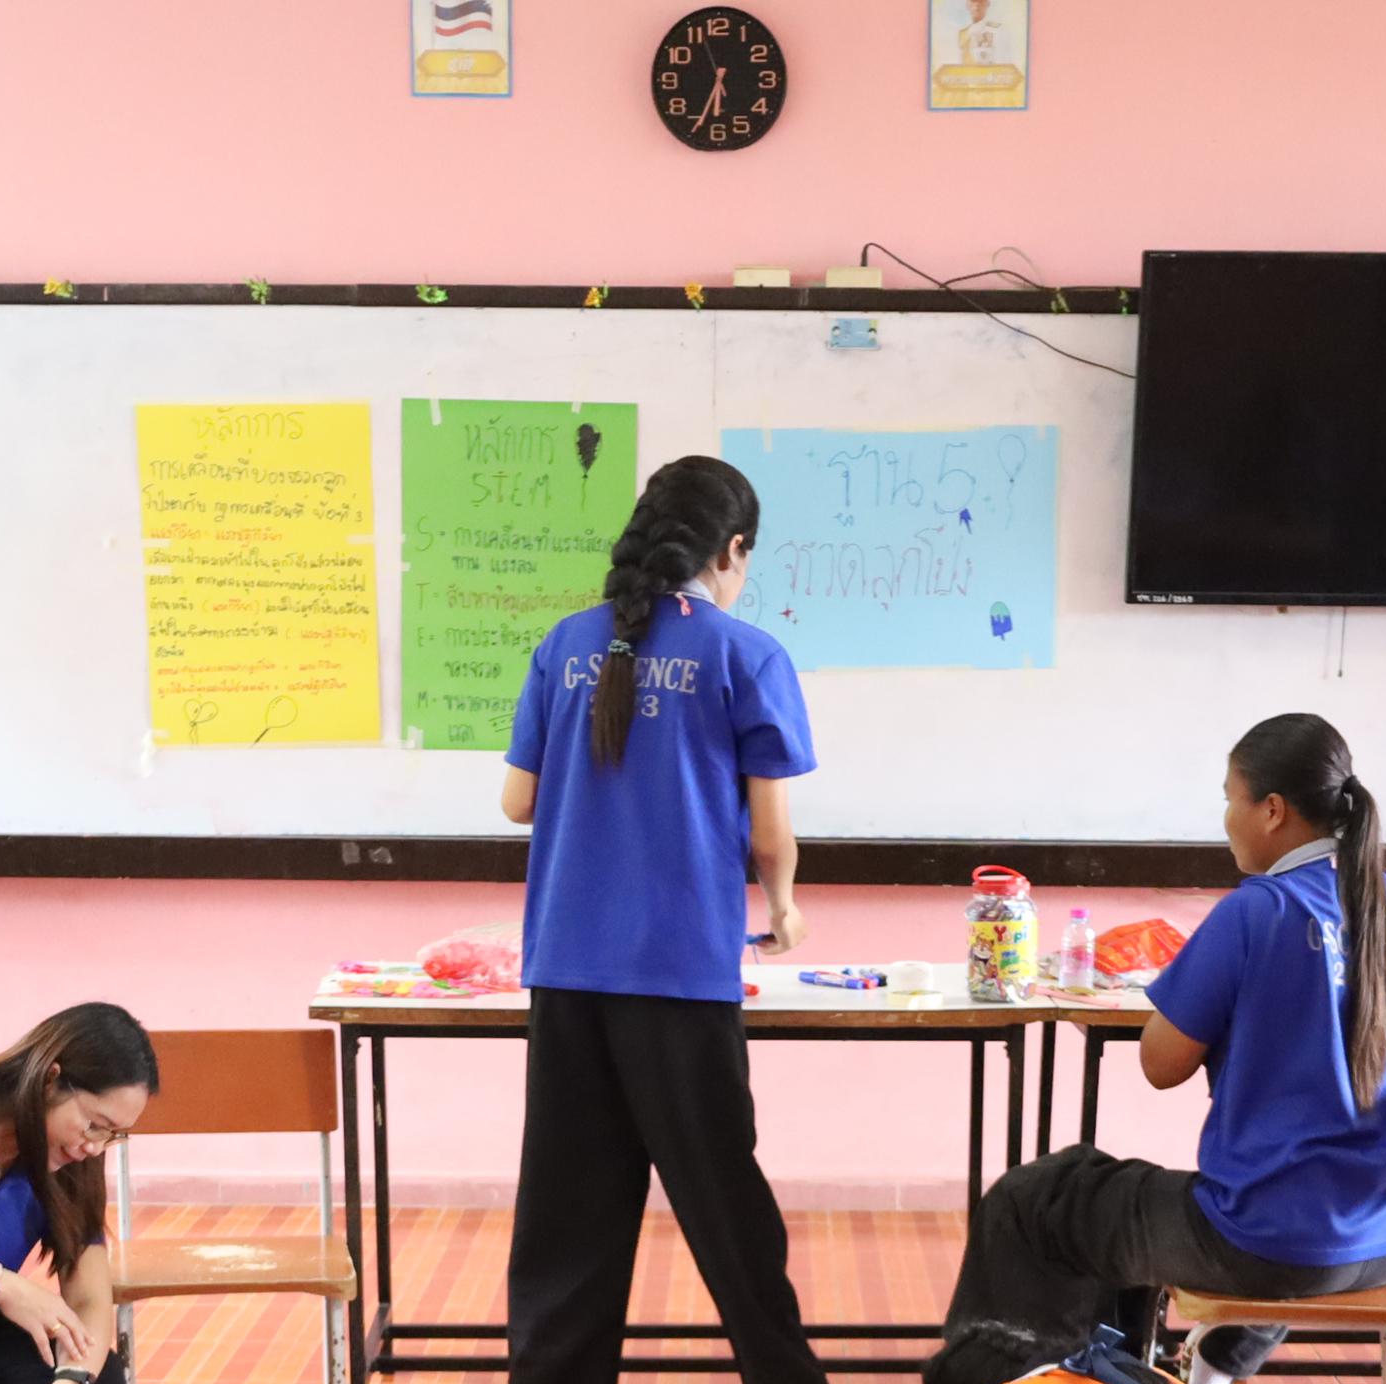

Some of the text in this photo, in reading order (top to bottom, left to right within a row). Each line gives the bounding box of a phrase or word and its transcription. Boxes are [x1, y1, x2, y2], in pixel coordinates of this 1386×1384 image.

[687, 26, 702, 43] 11
[706, 17, 730, 36] 12
[740, 25, 746, 42] 1
[669, 46, 692, 64] 10
[750, 44, 768, 63] 2
[661, 72, 679, 89] 9
[758, 70, 777, 88] 3
[669, 98, 686, 115] 8
[751, 97, 769, 115] 4
[710, 124, 727, 141] 6
[733, 115, 750, 133] 5
[191, 405, 306, 441] หลักการ
[463, 415, 559, 465] หลักการ
[470, 470, 552, 509] STEM
[414, 515, 435, 552] S
